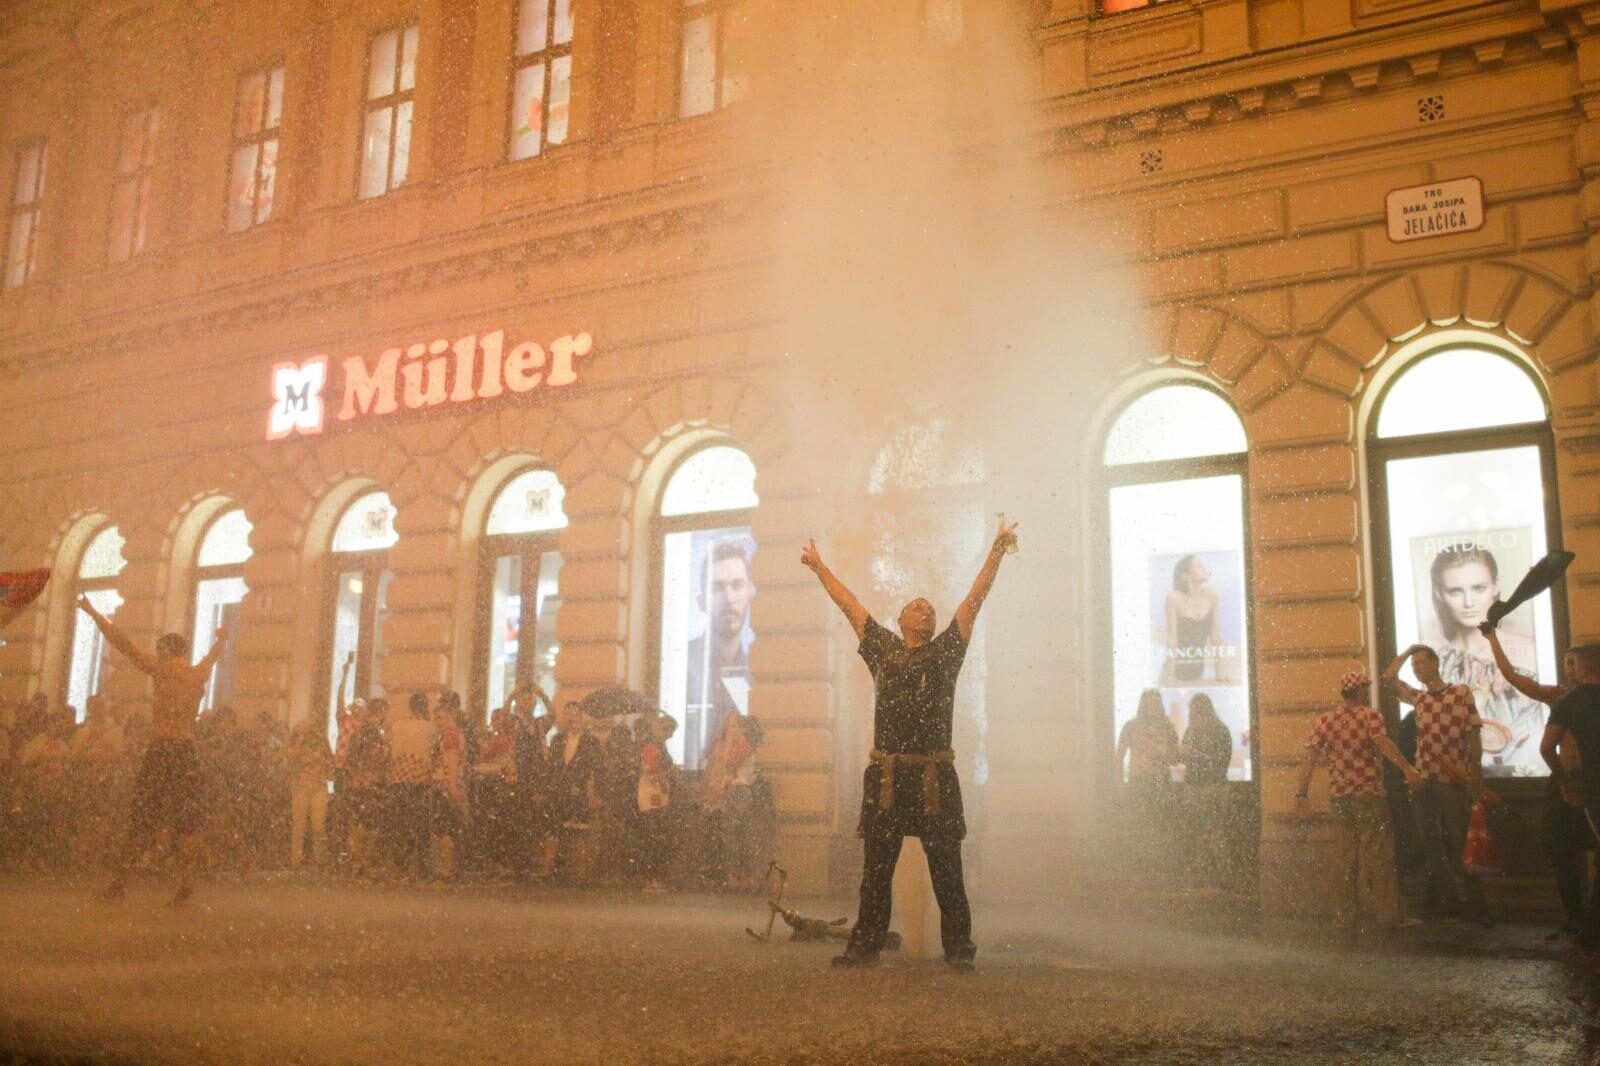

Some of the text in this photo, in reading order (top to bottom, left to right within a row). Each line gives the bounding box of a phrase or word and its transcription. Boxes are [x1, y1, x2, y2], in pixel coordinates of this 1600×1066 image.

[1424, 189, 1443, 198] TRG
[1403, 197, 1464, 214] BANA JOSIPA
[1404, 211, 1466, 235] JELAČIĆA
[283, 329, 593, 421] M Müller
[1423, 531, 1517, 555] ARTDECO
[1160, 645, 1236, 658] ANCASTER
